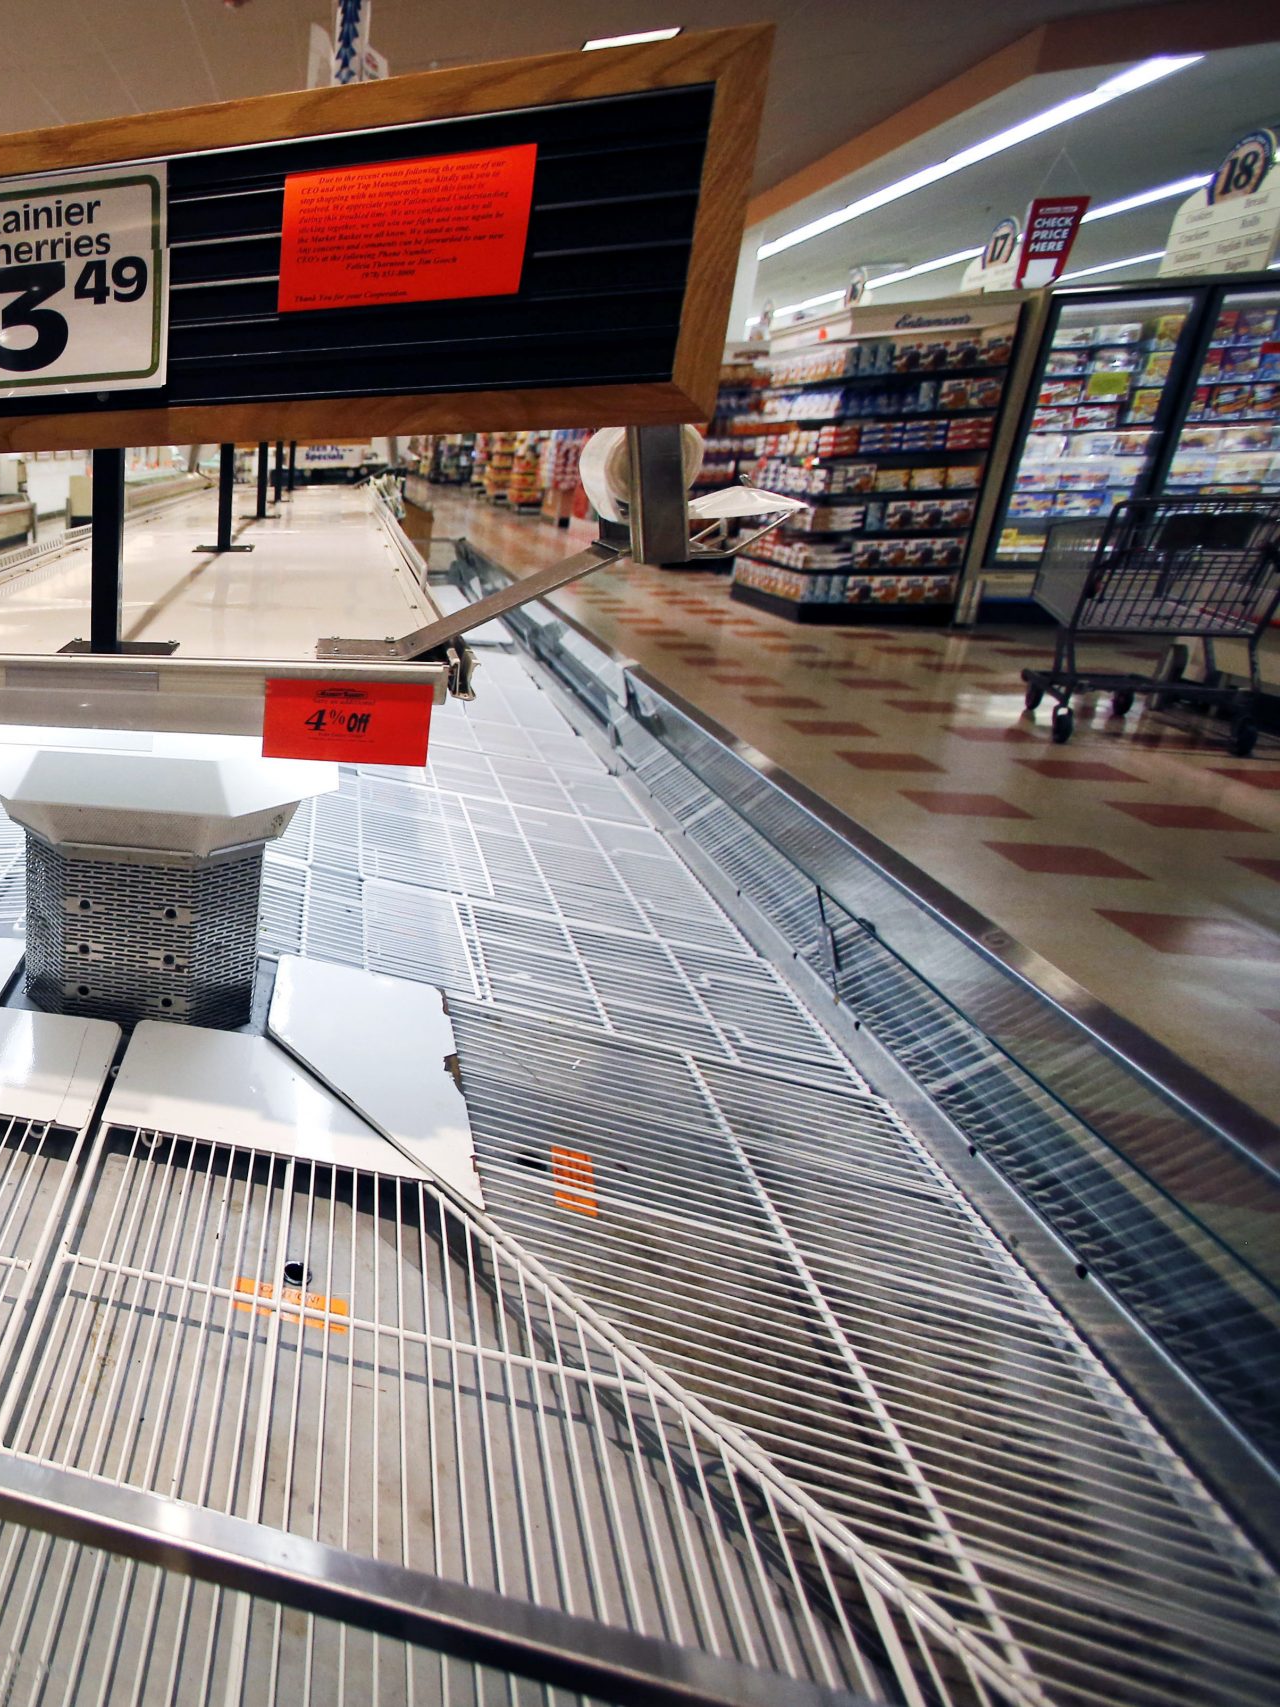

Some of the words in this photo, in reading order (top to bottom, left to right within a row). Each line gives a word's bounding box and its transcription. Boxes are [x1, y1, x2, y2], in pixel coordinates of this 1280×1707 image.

[1220, 150, 1260, 196] 18
[1034, 216, 1075, 229] CHECK
[1031, 228, 1070, 241] PRICE
[988, 232, 1012, 264] 17
[1028, 240, 1064, 252] HERE
[347, 713, 371, 733] Off
